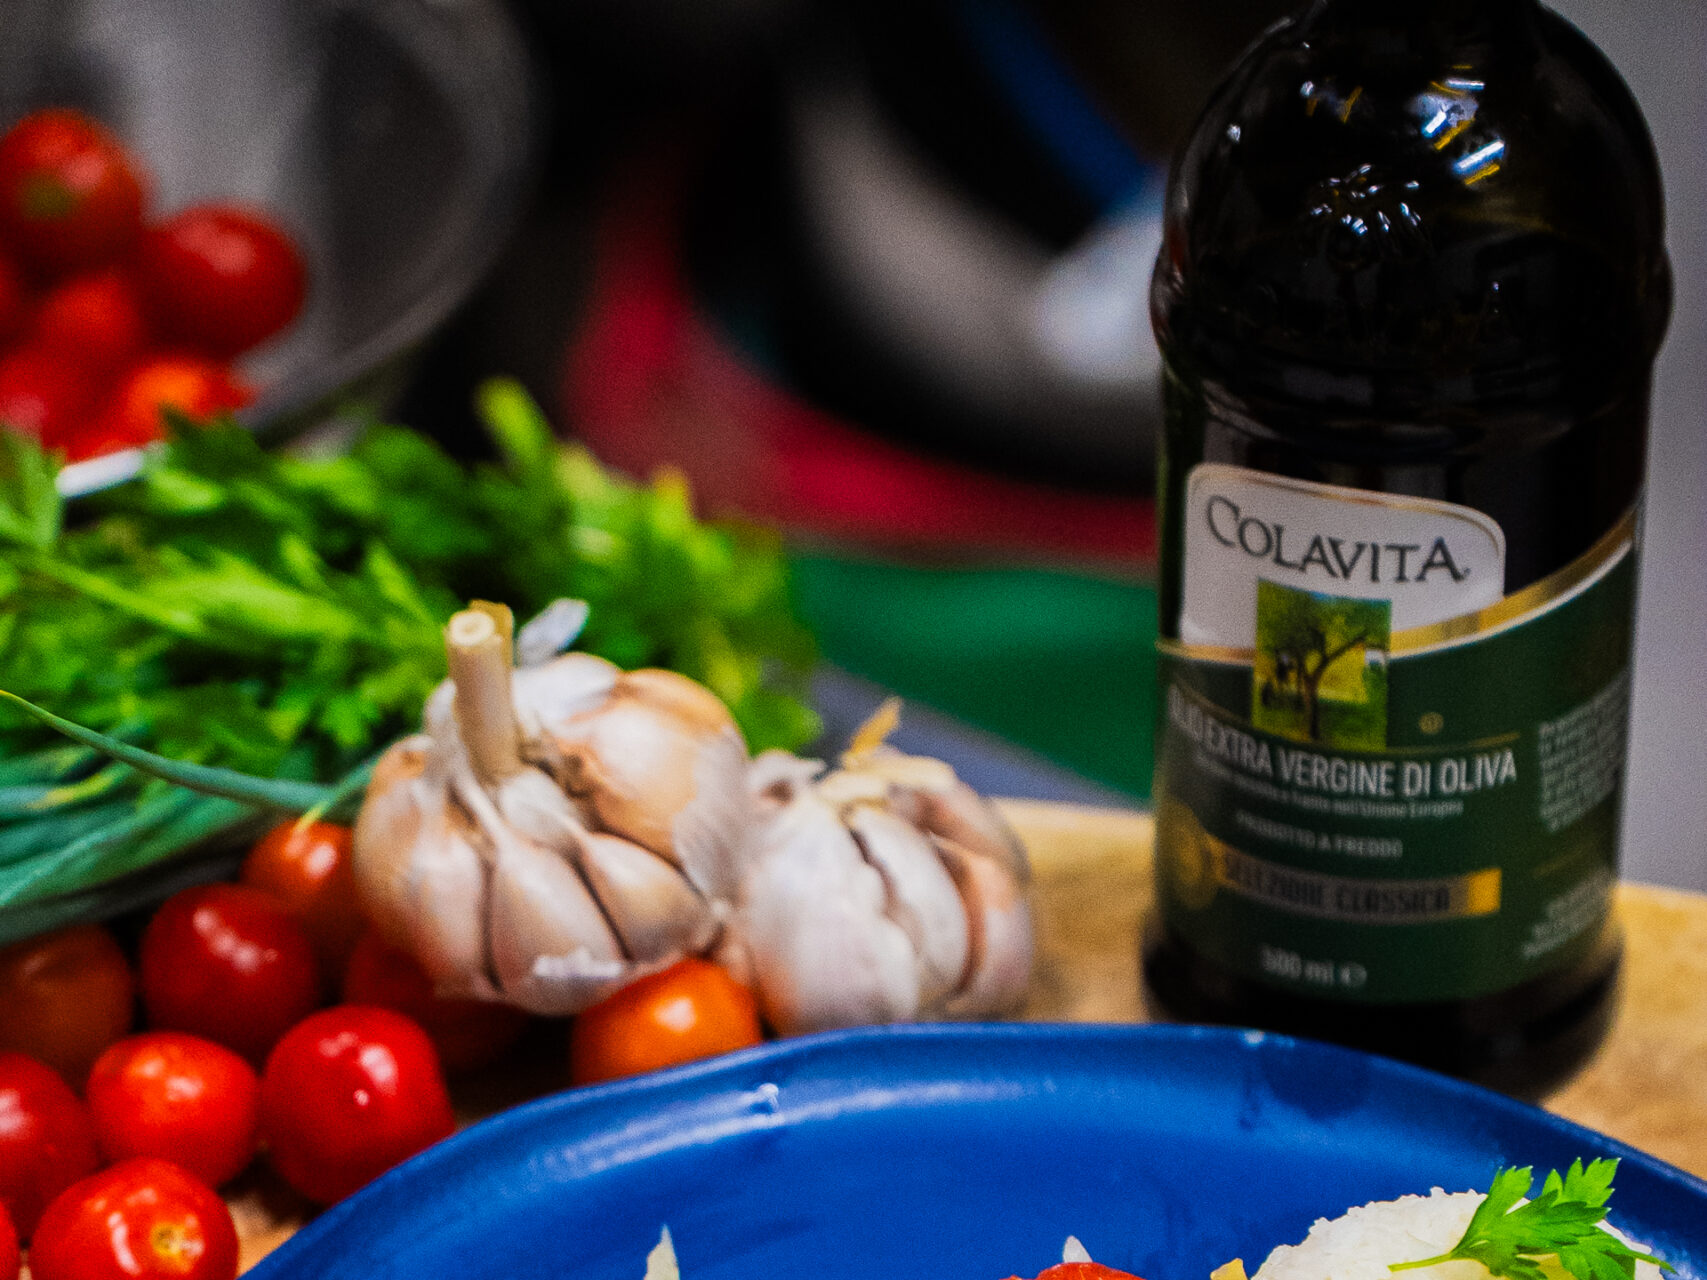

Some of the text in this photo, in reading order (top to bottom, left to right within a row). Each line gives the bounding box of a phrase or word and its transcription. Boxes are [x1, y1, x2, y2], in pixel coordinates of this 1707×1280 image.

[1206, 496, 1469, 583] COLAVITA
[1204, 717, 1273, 779] EXTRA
[1277, 748, 1396, 797] VERGINE
[1402, 761, 1431, 797] DI
[1437, 748, 1517, 794] OLIVA
